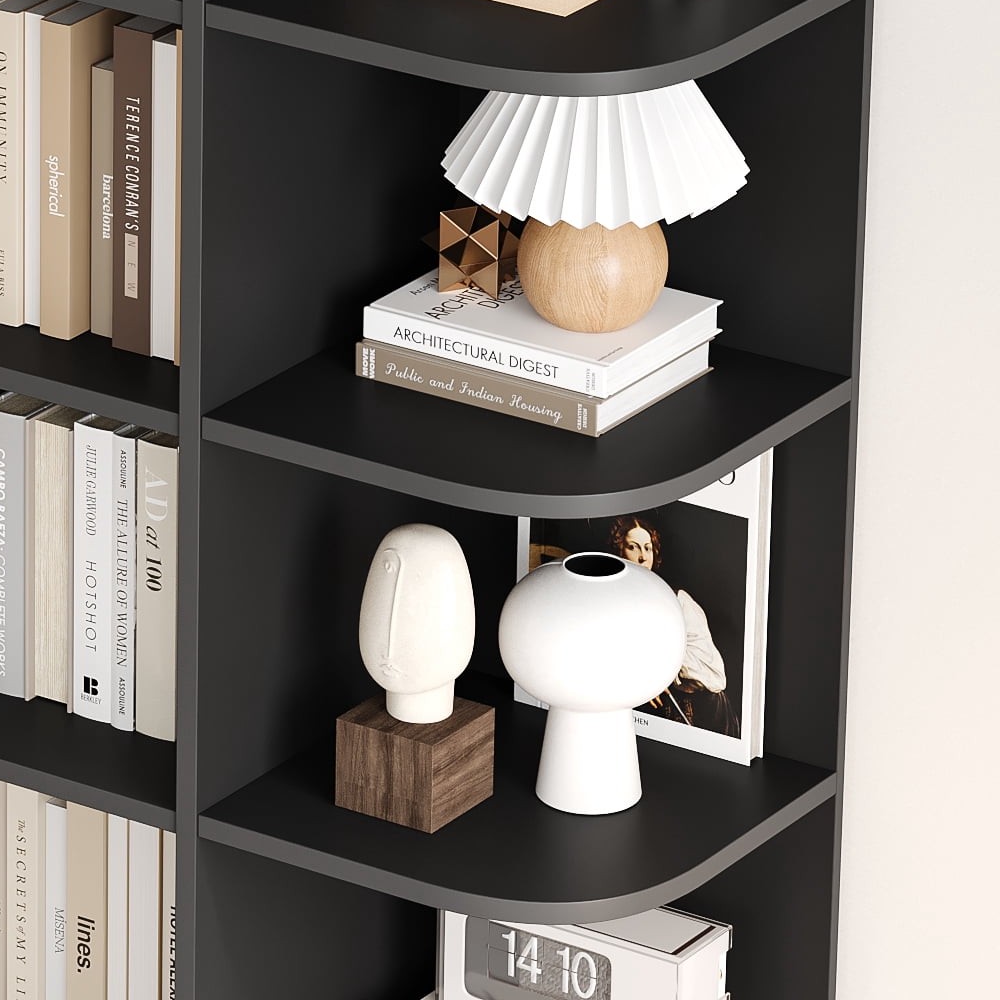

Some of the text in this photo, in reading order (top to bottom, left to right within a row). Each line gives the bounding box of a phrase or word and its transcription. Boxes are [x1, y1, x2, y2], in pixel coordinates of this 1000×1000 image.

[125, 96, 141, 162] TERENCE
[45, 155, 65, 218] spherical
[102, 174, 114, 239] barcelona
[393, 326, 559, 379] ARCHITECTURAL DIGEST
[385, 362, 562, 424] Public and Indian Housing
[86, 444, 97, 536] JULIE GARWOOD
[145, 465, 168, 592] AD at 100
[85, 560, 97, 652] HOTSHOT
[116, 500, 128, 667] THE ALLURE OF WOMEN
[77, 915, 96, 974] lines.
[501, 930, 598, 999] 14 10
